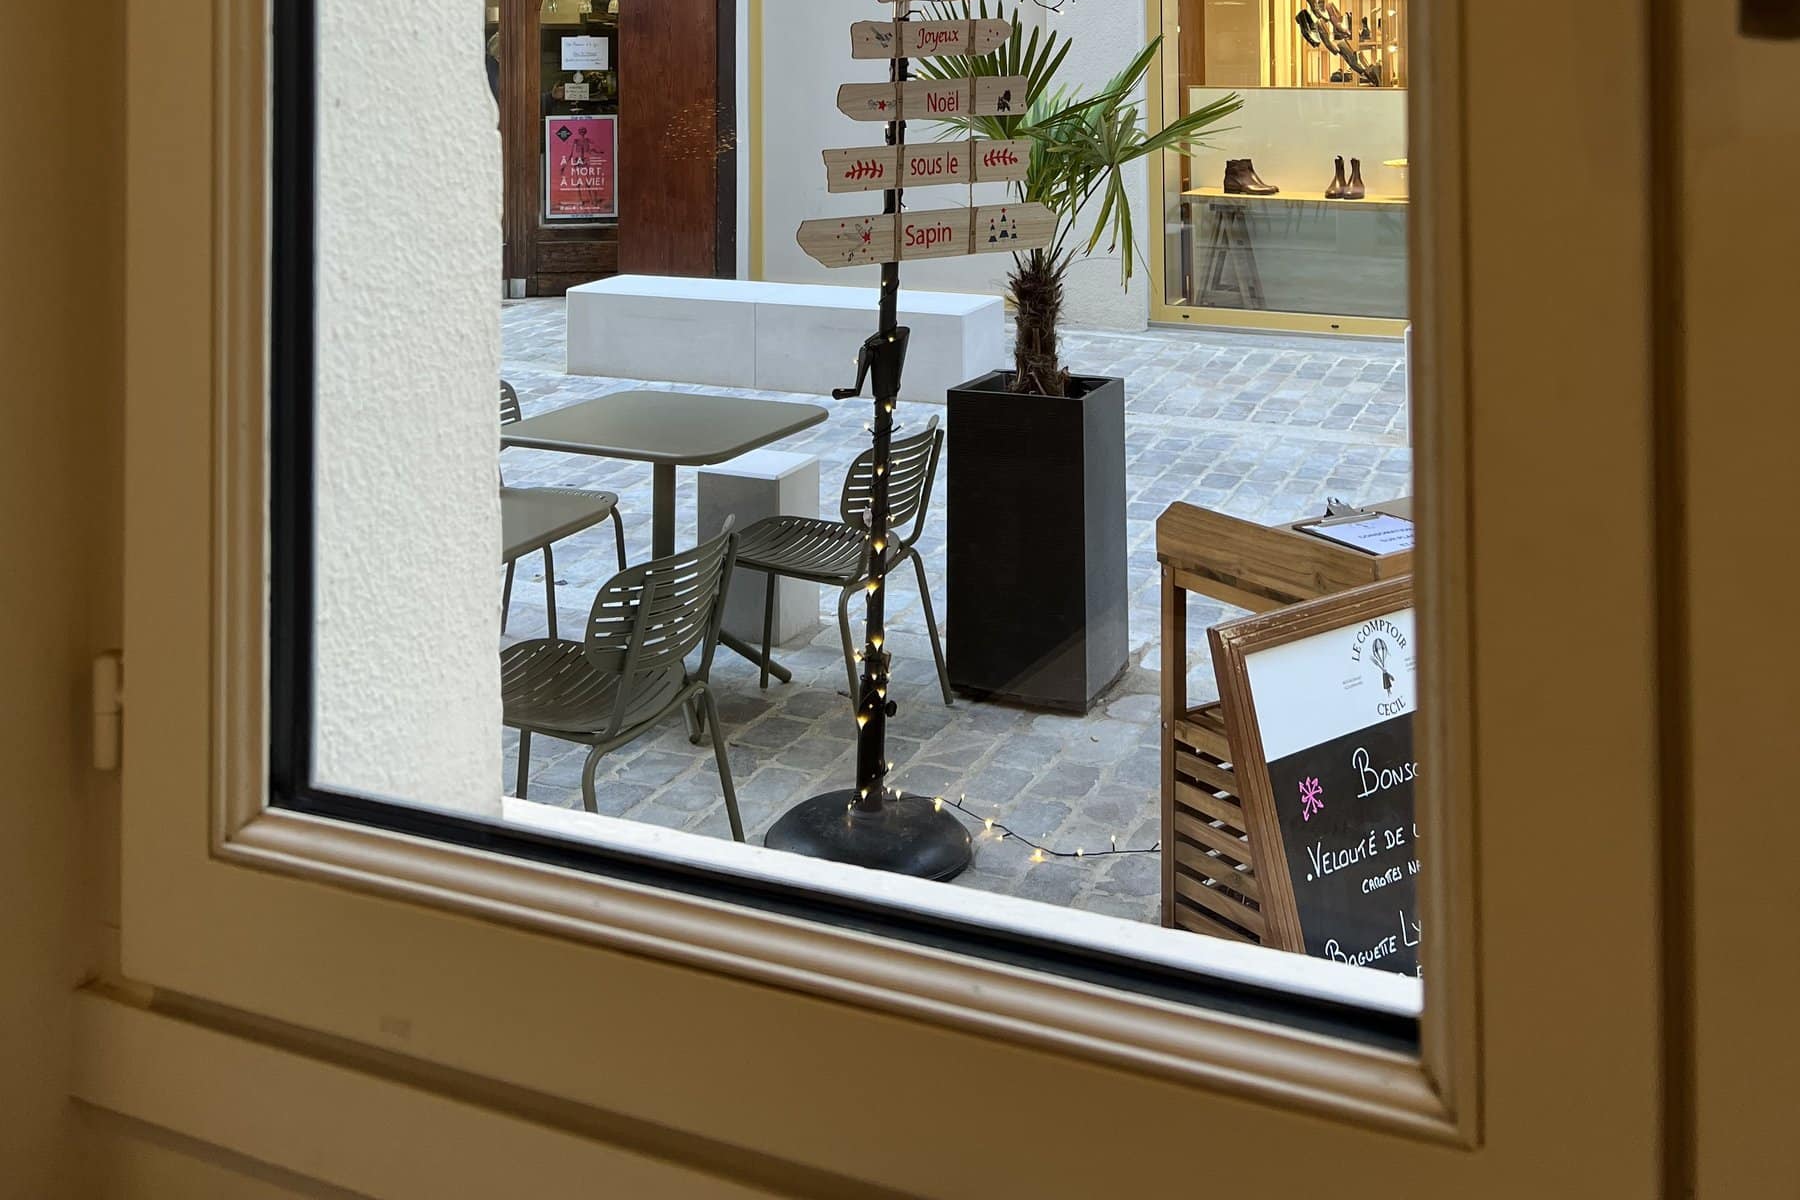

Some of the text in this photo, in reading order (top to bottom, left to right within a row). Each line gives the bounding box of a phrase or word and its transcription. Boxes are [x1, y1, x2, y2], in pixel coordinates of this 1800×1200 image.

[916, 28, 959, 52] Joyeux
[926, 92, 959, 113] Noël
[570, 157, 584, 166] LA
[910, 153, 959, 176] sous le
[570, 178, 584, 186] LA
[905, 221, 952, 251] Sapin
[1351, 619, 1407, 662] LE COMPTOIR
[1384, 826, 1405, 850] DE
